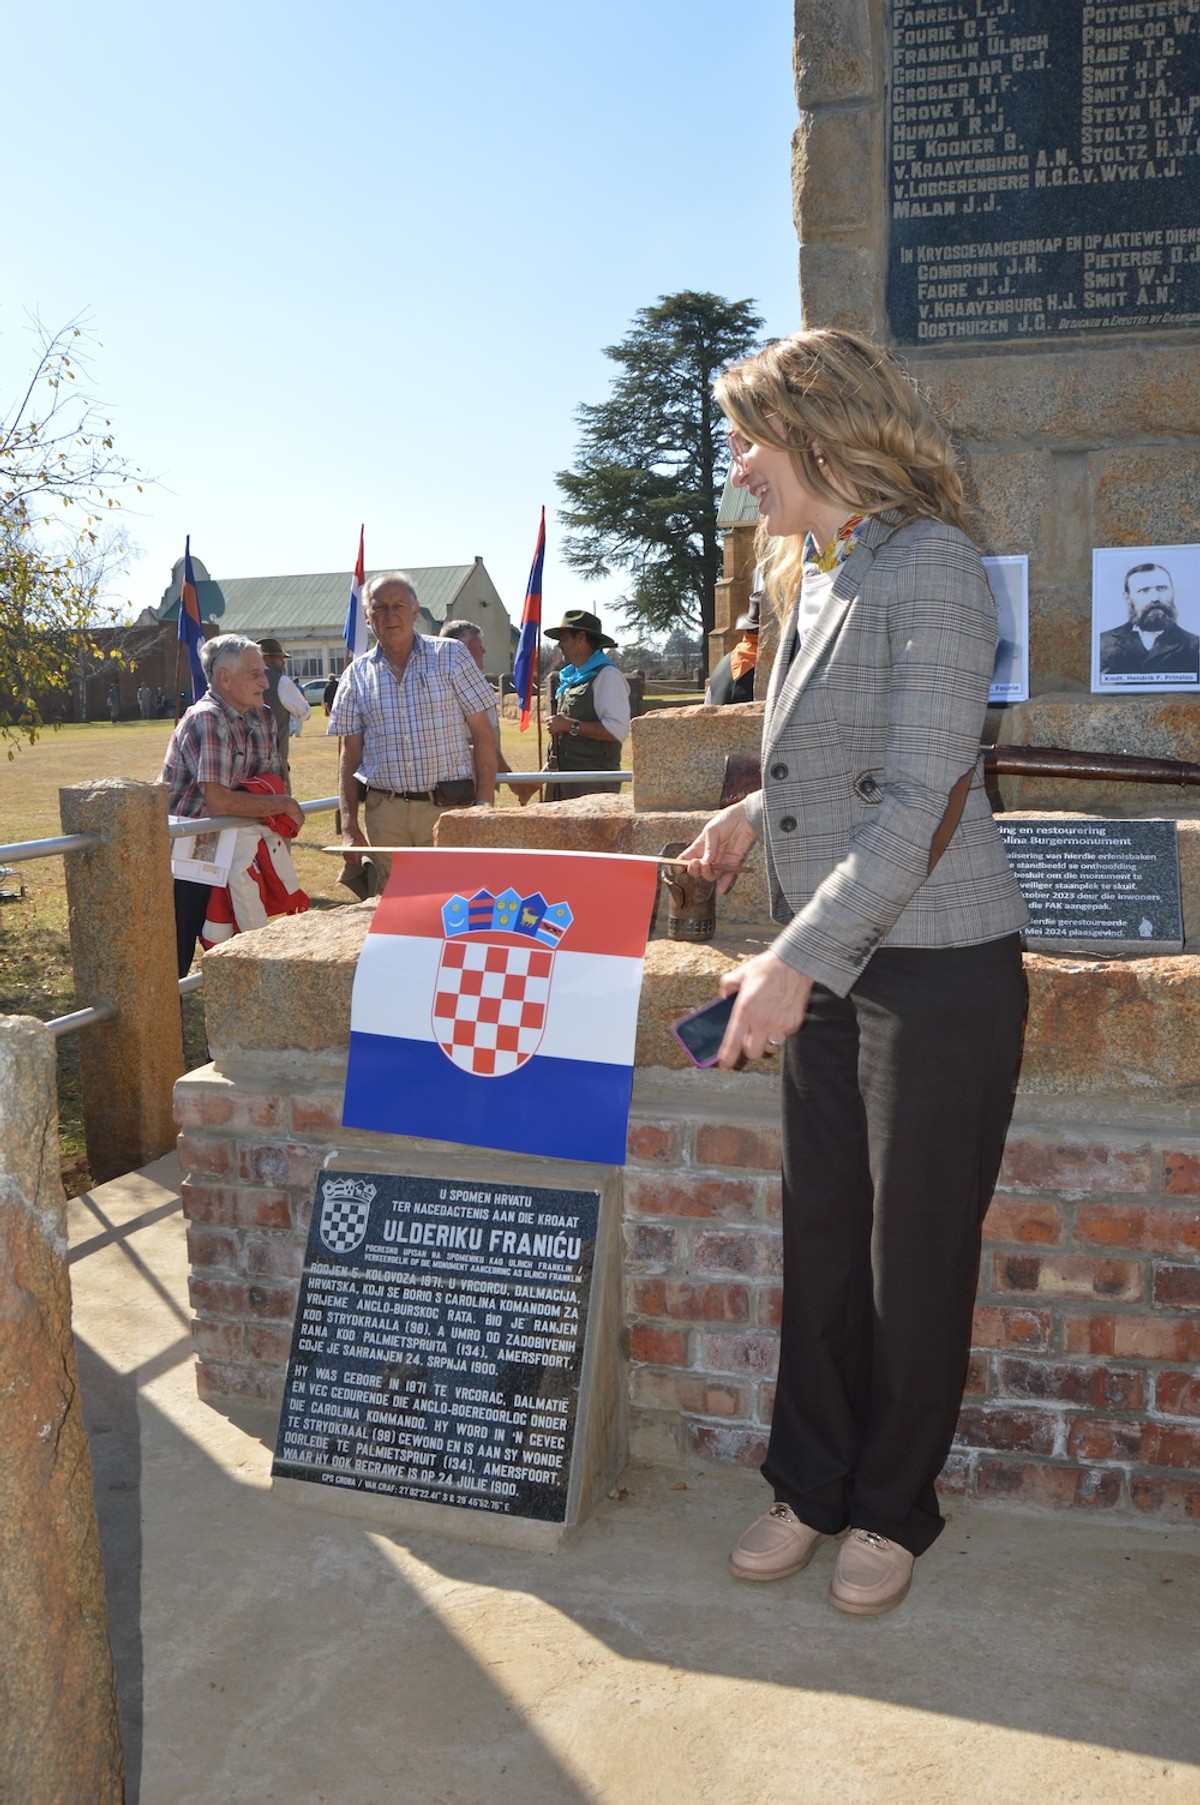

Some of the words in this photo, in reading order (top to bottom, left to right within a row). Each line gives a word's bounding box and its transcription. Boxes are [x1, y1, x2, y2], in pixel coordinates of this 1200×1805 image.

[995, 684, 1020, 692] Fourie
[1127, 674, 1154, 682] Hendrik
[1019, 827, 1033, 835] en
[1036, 826, 1106, 837] restourering
[1030, 836, 1132, 846] Burgermonument
[1016, 861, 1067, 869] standbeeld
[1064, 852, 1096, 860] hierdie
[1014, 871, 1045, 879] besluit
[1063, 871, 1078, 879] die
[1080, 872, 1132, 880] monument
[1028, 901, 1043, 909] die
[1052, 891, 1076, 899] 2023
[1101, 892, 1116, 900] die
[1044, 927, 1067, 935] 2024
[440, 1188, 447, 1200] U
[450, 1189, 491, 1205] SPOMEN
[494, 1193, 532, 1207] HRVATU
[392, 1200, 411, 1213] TER
[492, 1210, 514, 1223] AAN
[518, 1212, 534, 1225] DIE
[537, 1213, 579, 1229] KROAAT
[383, 1219, 483, 1250] ULDERIKU
[489, 1230, 582, 1260] FRANIĆU
[310, 1262, 349, 1275] RODJEN
[365, 1268, 416, 1286] KOLOVOZA
[448, 1277, 456, 1290] U
[308, 1277, 359, 1295] HRVATSKA,
[362, 1283, 385, 1297] KOJI
[387, 1286, 400, 1299] SE
[403, 1287, 432, 1303] BORIO
[435, 1291, 443, 1304] S
[445, 1293, 496, 1310] CAROLINA
[499, 1298, 560, 1317] KOMANDOM
[563, 1306, 579, 1319] ZA
[306, 1292, 349, 1309] VRIJEME
[447, 1309, 477, 1324] RATA.
[485, 1314, 502, 1327] BIO
[510, 1317, 525, 1330] JE
[533, 1319, 578, 1336] RANJEN
[301, 1323, 328, 1338] RANA
[336, 1328, 356, 1341] KOD
[363, 1331, 448, 1354] PALMIETSPRUITA
[303, 1308, 322, 1321] KOD
[327, 1311, 399, 1331] STRYDKRAALA
[437, 1325, 445, 1337] A
[451, 1326, 481, 1341] UMRO
[486, 1331, 501, 1344] OD
[505, 1333, 576, 1353] ZADOBIVENIH
[326, 1343, 340, 1355] JE
[342, 1344, 403, 1364] SAHRANJEN
[405, 1352, 424, 1366] 24.
[427, 1355, 467, 1372] SRPNJA
[471, 1361, 499, 1376] 1900.
[295, 1364, 308, 1377] HY
[315, 1367, 338, 1382] WAS
[388, 1377, 400, 1391] IN
[406, 1380, 427, 1395] 1871
[434, 1383, 448, 1397] TE
[514, 1394, 570, 1414] DALMATIË
[289, 1398, 306, 1412] DIE
[311, 1401, 360, 1420] CAROLINA
[366, 1409, 428, 1430] KOMMANDO.
[434, 1419, 449, 1433] HY
[456, 1422, 488, 1439] WORD
[494, 1428, 506, 1442] IN
[292, 1380, 306, 1394] EN
[392, 1394, 410, 1409] DIE
[530, 1416, 567, 1431] ONDER
[284, 1430, 330, 1450] OORLEDE
[336, 1439, 350, 1453] TE
[355, 1442, 437, 1466] PALMIETSPRUIT
[288, 1415, 301, 1429] TE
[303, 1417, 369, 1440] STRYDKRAAL
[446, 1440, 461, 1454] EN
[463, 1442, 474, 1455] IS
[477, 1444, 501, 1460] AAN
[504, 1448, 519, 1461] SY
[522, 1451, 563, 1468] WONDE
[283, 1447, 313, 1463] WAAR
[315, 1452, 330, 1466] HY
[331, 1454, 353, 1470] OOK
[408, 1468, 418, 1481] IS
[420, 1469, 436, 1483] OP
[438, 1472, 454, 1487] 24
[456, 1475, 488, 1492] JULIE
[490, 1480, 520, 1497] 1900.
